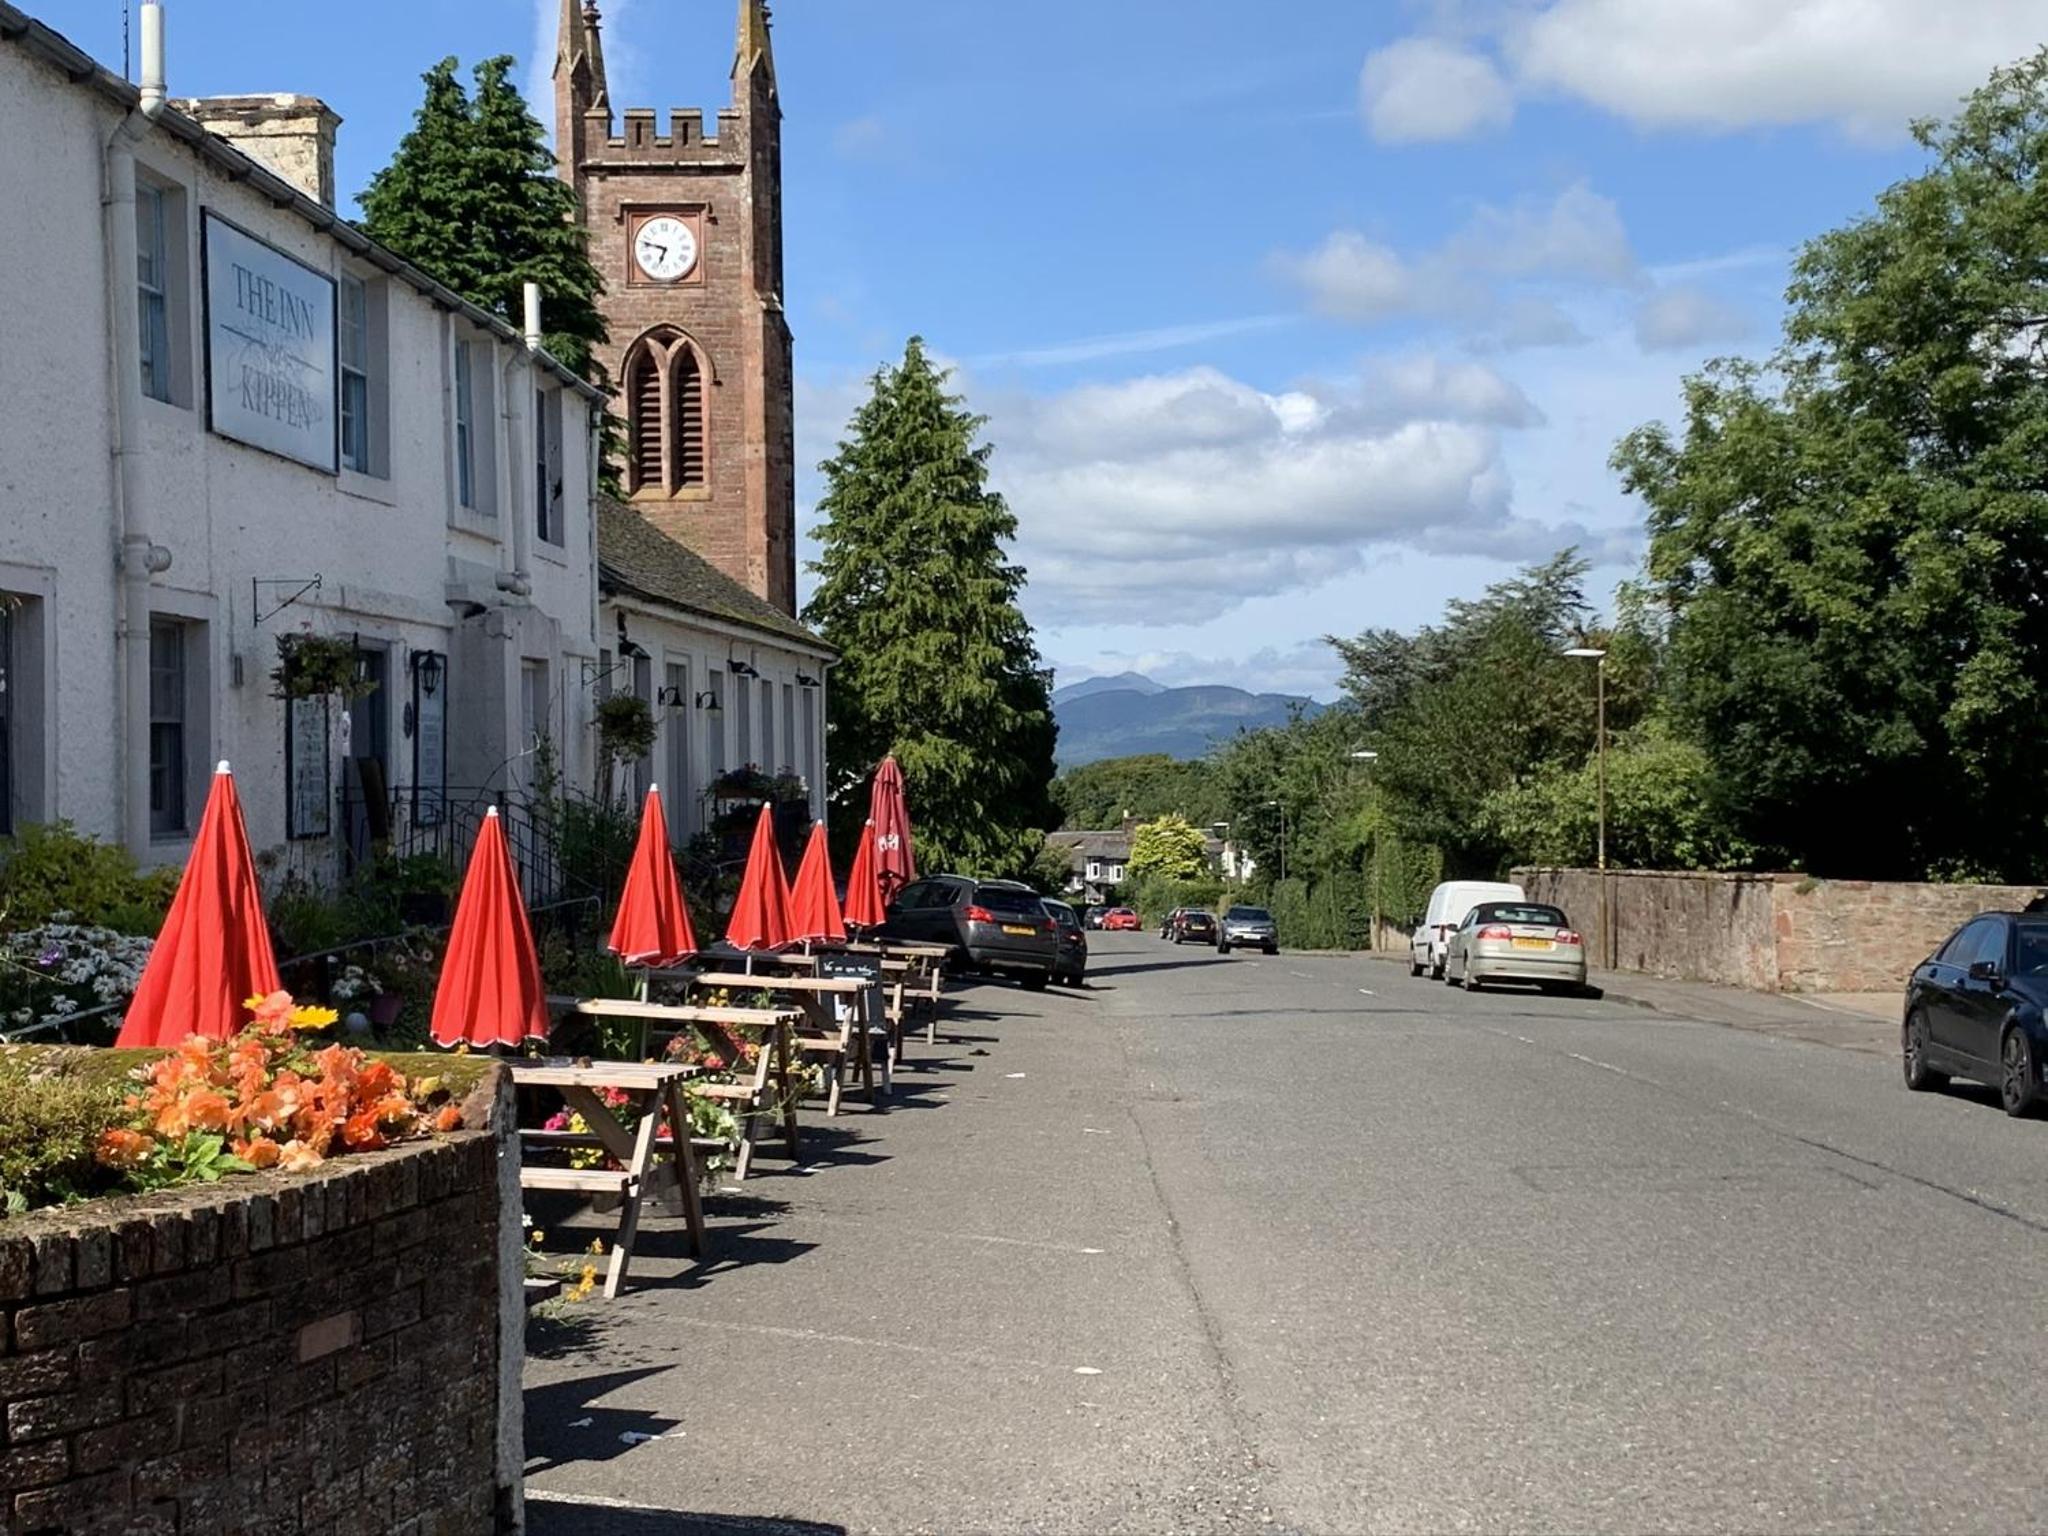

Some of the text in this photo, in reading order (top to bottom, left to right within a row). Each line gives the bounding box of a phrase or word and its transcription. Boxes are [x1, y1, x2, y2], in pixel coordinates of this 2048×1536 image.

[231, 262, 315, 343] THE INN
[241, 364, 313, 432] KIPPEN
